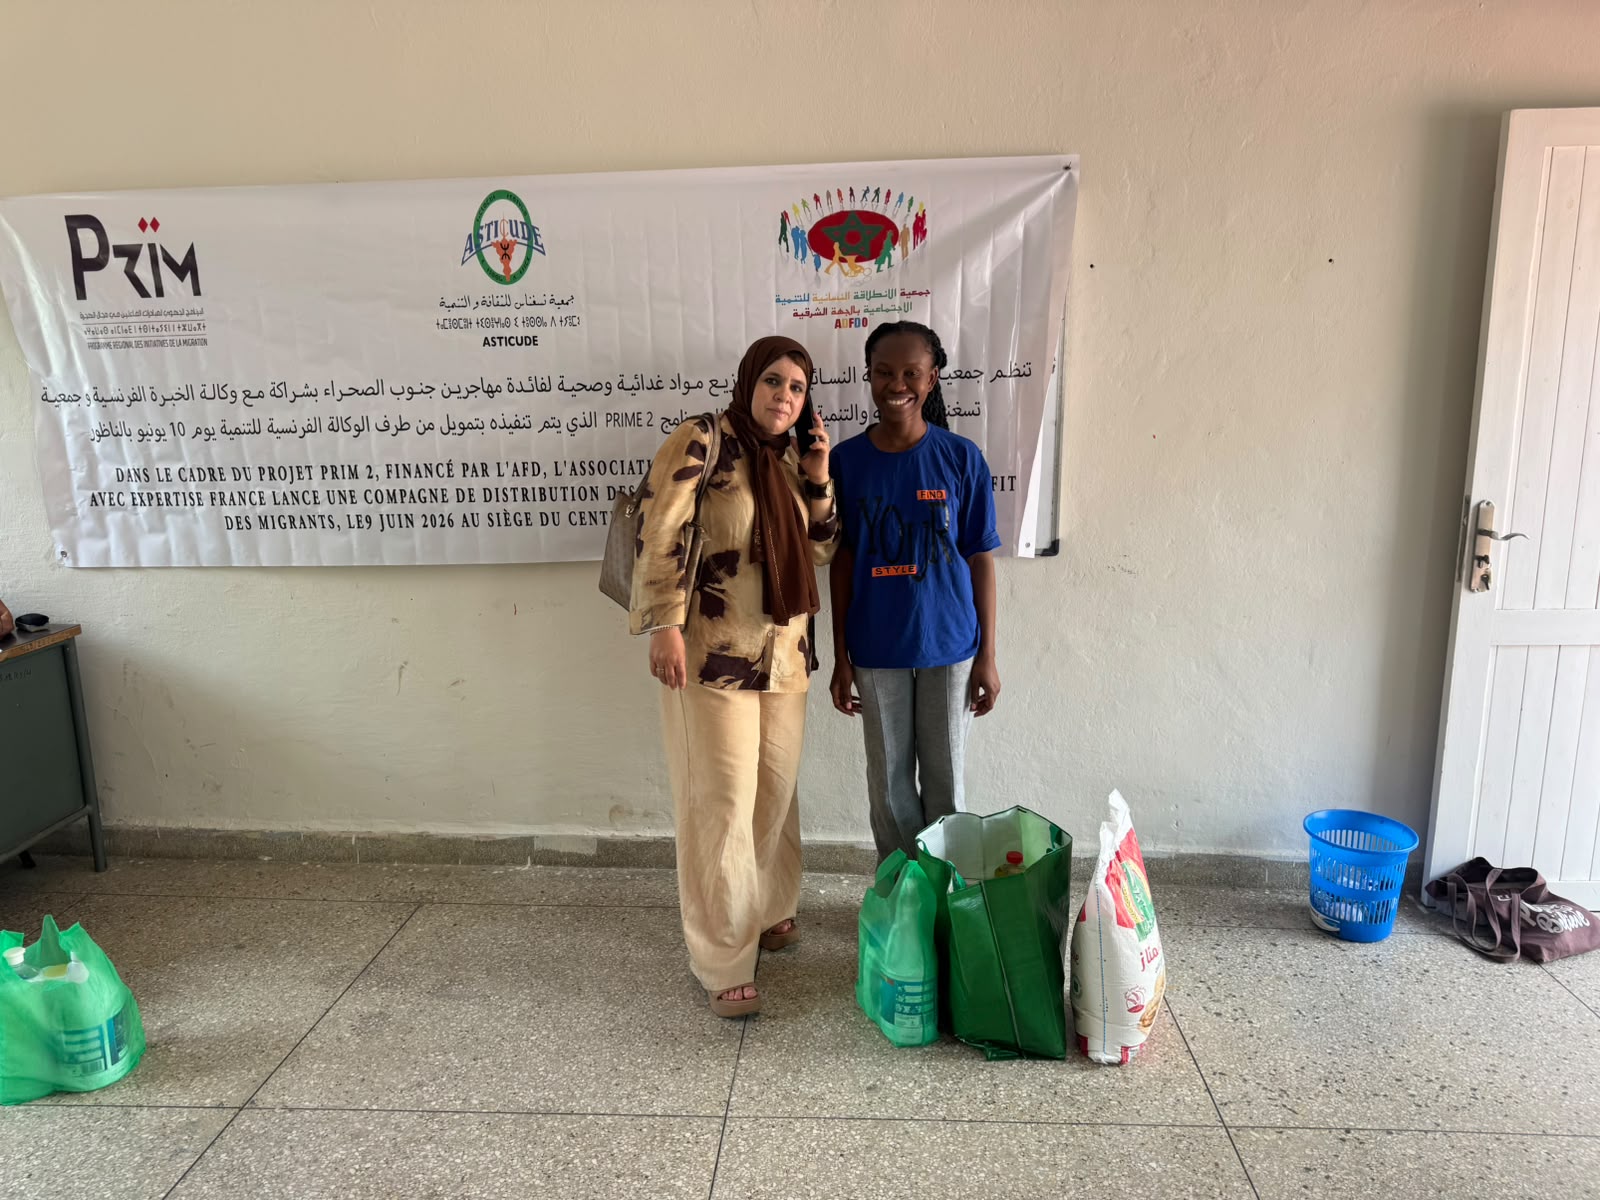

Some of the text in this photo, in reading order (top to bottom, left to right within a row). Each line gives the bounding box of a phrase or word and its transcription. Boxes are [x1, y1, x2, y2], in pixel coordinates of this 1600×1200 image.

[462, 219, 546, 260] ASTICUDE
[64, 214, 201, 300] PRIM
[439, 295, 471, 312] التنمية
[473, 300, 479, 311] و
[481, 293, 512, 308] للثقافة
[549, 294, 574, 310] جمعية
[775, 288, 931, 306] جمعية الانطلاقة النسائية للتنمية
[792, 302, 913, 320] الاجتماعية بالجهة الشرقية
[834, 317, 868, 329] ADFDO
[482, 335, 539, 347] ASTICUDE
[938, 366, 984, 386] جمعي
[989, 360, 1032, 383] تنظم
[200, 383, 237, 404] وكالة
[270, 381, 319, 403] بشراكة
[323, 379, 385, 402] الصحراء
[389, 382, 436, 400] جنوب
[441, 376, 502, 399] مهاجرين
[507, 375, 552, 393] لفائدة
[557, 375, 613, 397] وصحية
[617, 373, 665, 396] غدائية
[669, 373, 704, 395] مواد
[41, 386, 82, 408] جمعية
[86, 393, 91, 407] و
[93, 385, 146, 408] الفرنسية
[150, 384, 195, 407] الخبرة
[242, 389, 265, 407] مع
[169, 421, 186, 437] 10
[220, 418, 261, 440] للتنمية
[267, 416, 322, 439] الفرنسية
[327, 415, 370, 438] الوكالة
[375, 414, 411, 436] طرف
[416, 418, 435, 436] من
[440, 413, 485, 436] بتمويل
[490, 413, 532, 435] تنفيذه
[538, 416, 561, 434] يتم
[566, 411, 598, 437] الذي
[605, 412, 643, 428] PRIME
[646, 411, 654, 427] 2
[90, 420, 133, 443] بالناظور
[137, 423, 168, 443] يونيو
[191, 425, 216, 441] يوم
[115, 467, 150, 483] DANS
[156, 467, 173, 483] LE
[178, 466, 227, 482] CADRE
[231, 466, 252, 481] DU
[258, 465, 313, 484] PROJET
[320, 464, 359, 480] PRIM
[366, 464, 380, 481] 2,
[385, 459, 455, 479] FINANCÉ
[462, 462, 490, 478] PAR
[496, 461, 547, 479] L'AFD,
[89, 491, 125, 507] AVEC
[130, 490, 204, 507] EXPERTISE
[209, 490, 267, 507] FRANCE
[272, 489, 321, 506] LANCE
[326, 489, 358, 505] UNE
[364, 488, 448, 505] COMPAGNE
[456, 487, 476, 503] DE
[483, 485, 600, 503] DISTRIBUTION
[920, 490, 944, 499] FIND
[224, 509, 613, 532] DES MIGRANTS, LE9 JUIN 2026 AU SIÈGE DU CENT
[857, 496, 952, 582] YOUR
[875, 565, 915, 576] STYLE
